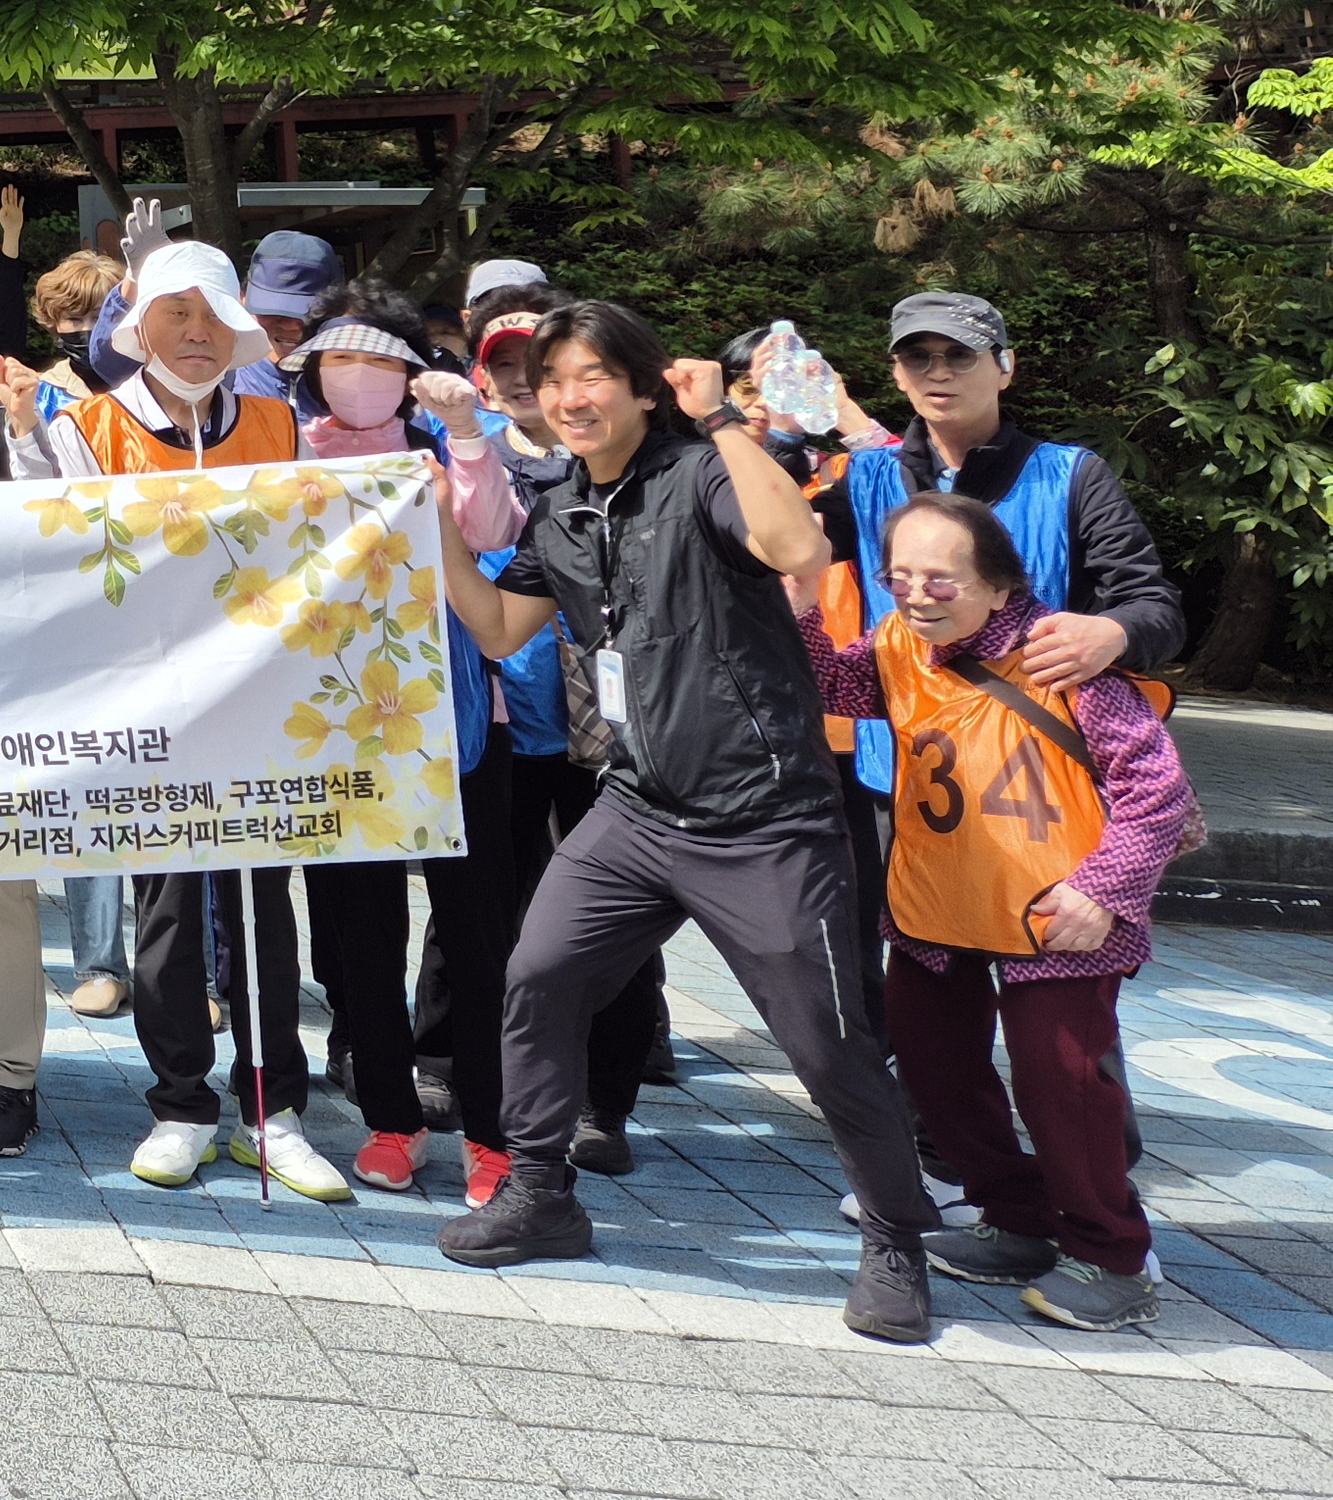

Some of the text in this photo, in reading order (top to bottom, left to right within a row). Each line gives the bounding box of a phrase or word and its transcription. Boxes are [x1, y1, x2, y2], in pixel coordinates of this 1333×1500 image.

[85, 784, 223, 817] 떡공방형제,
[229, 770, 385, 811] 구포연합식품,
[911, 729, 1062, 844] 34
[89, 810, 343, 853] 지저스커피트럭선교회
